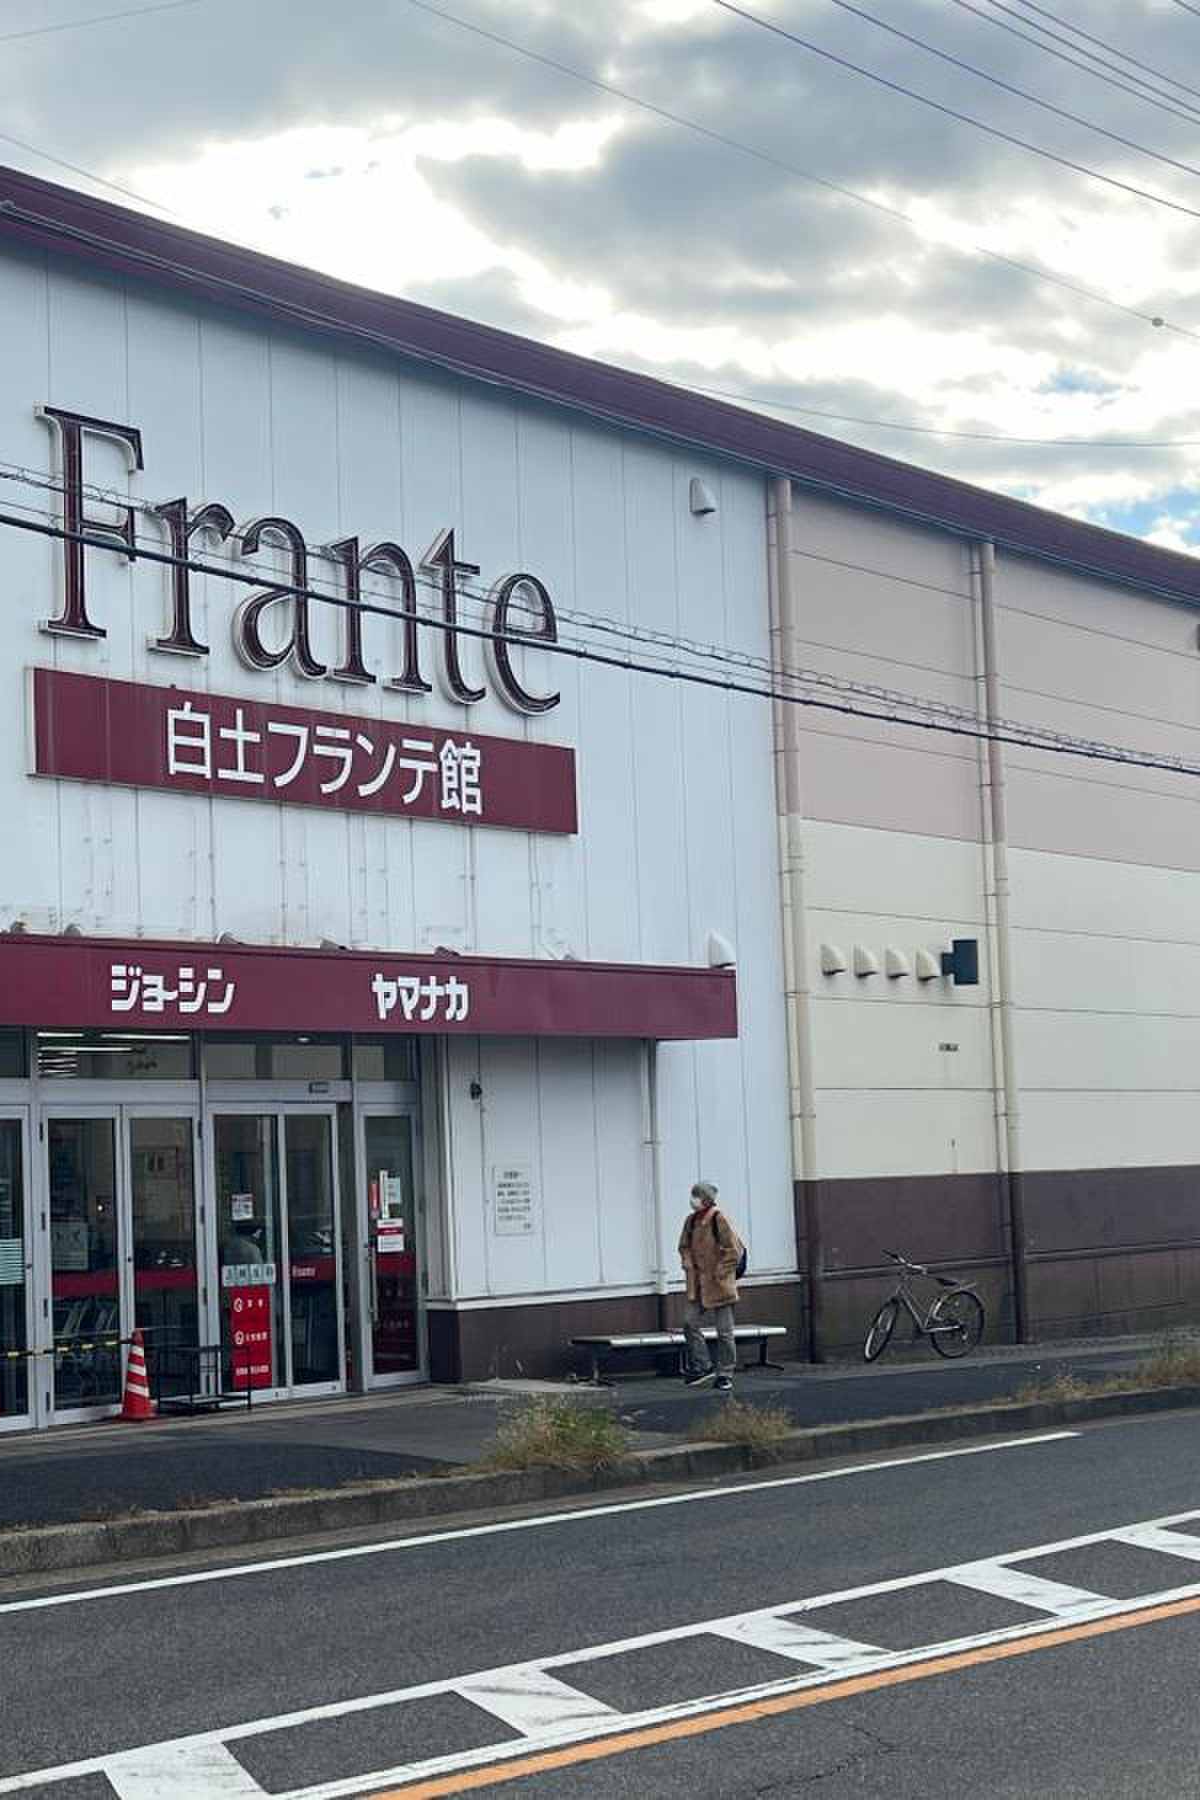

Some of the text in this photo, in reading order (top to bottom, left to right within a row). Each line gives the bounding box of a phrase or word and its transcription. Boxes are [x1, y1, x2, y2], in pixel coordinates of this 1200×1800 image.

[33, 403, 561, 717] Frante
[166, 701, 483, 816] 白土フランテ館
[111, 964, 470, 1022] ジョーシン ヤマナカ
